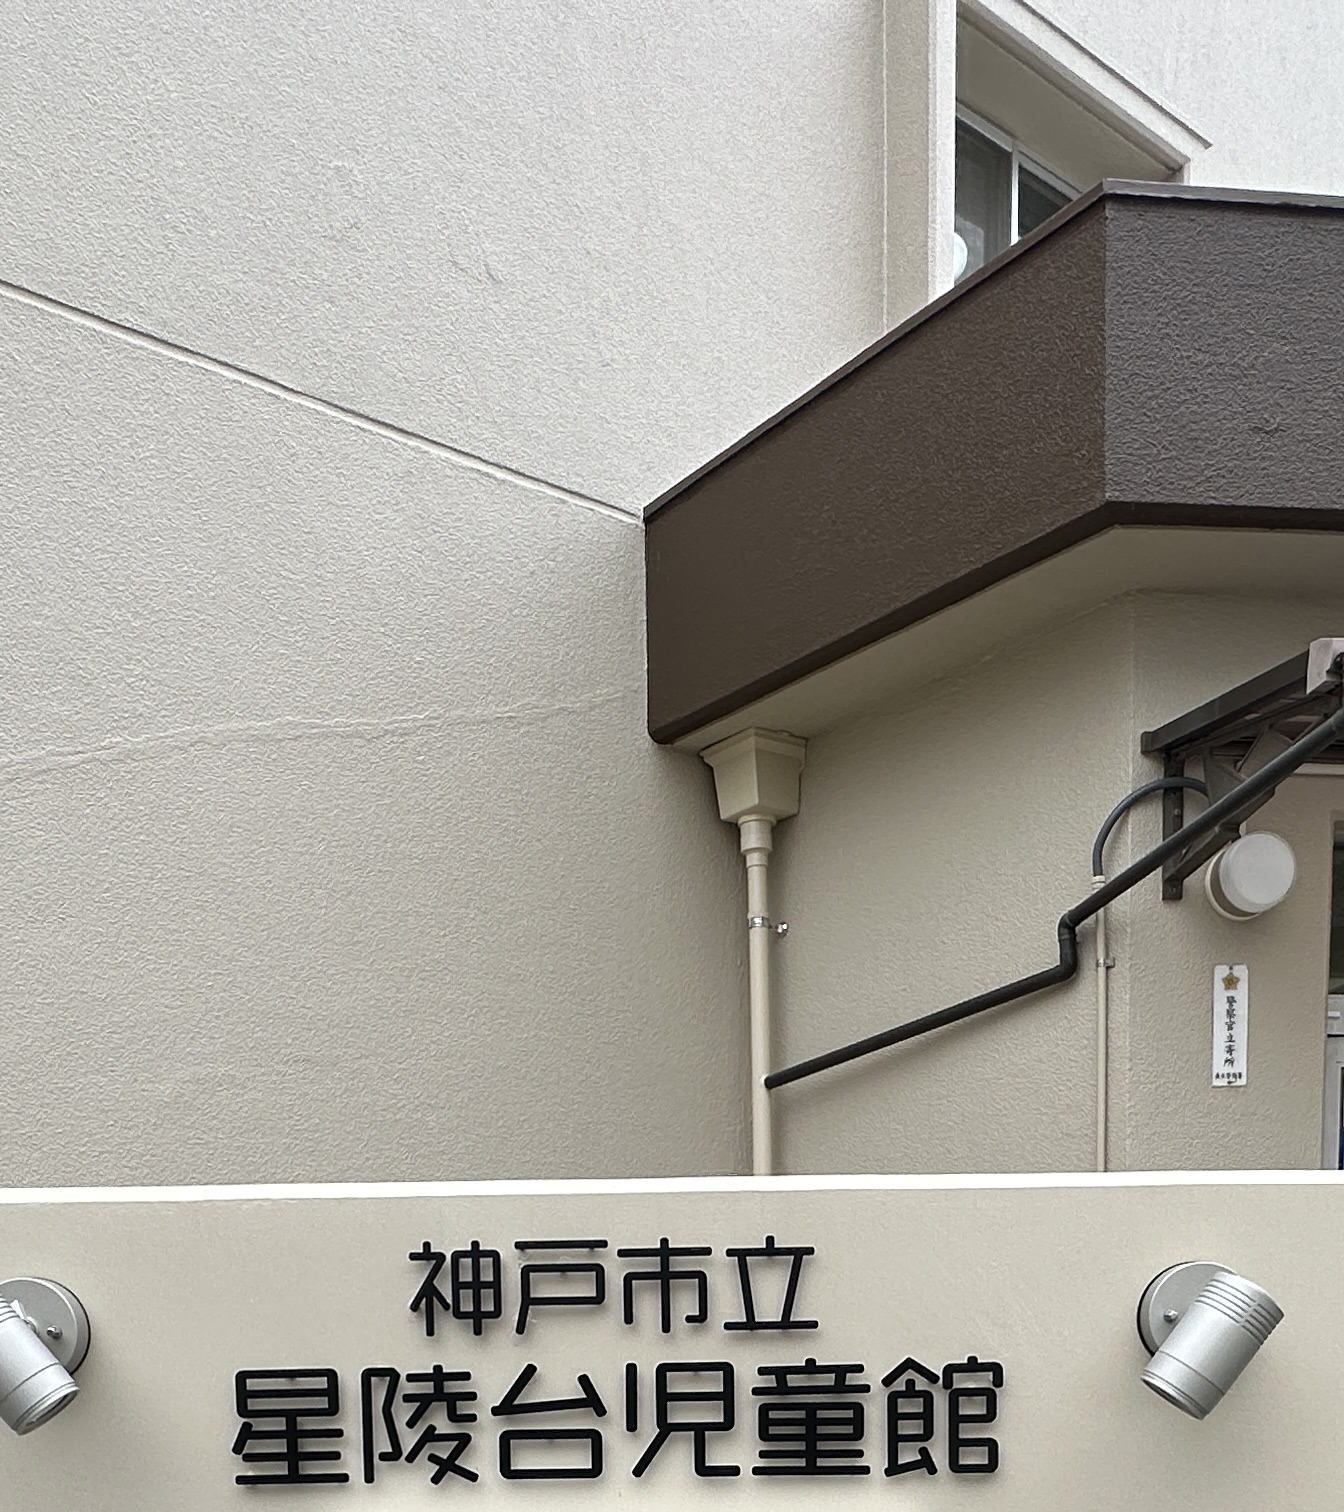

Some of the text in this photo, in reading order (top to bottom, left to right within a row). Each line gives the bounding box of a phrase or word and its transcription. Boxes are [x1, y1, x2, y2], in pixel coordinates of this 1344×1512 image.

[409, 1235, 819, 1337] 神戸市立
[231, 1355, 1004, 1485] 星陵台児童館
